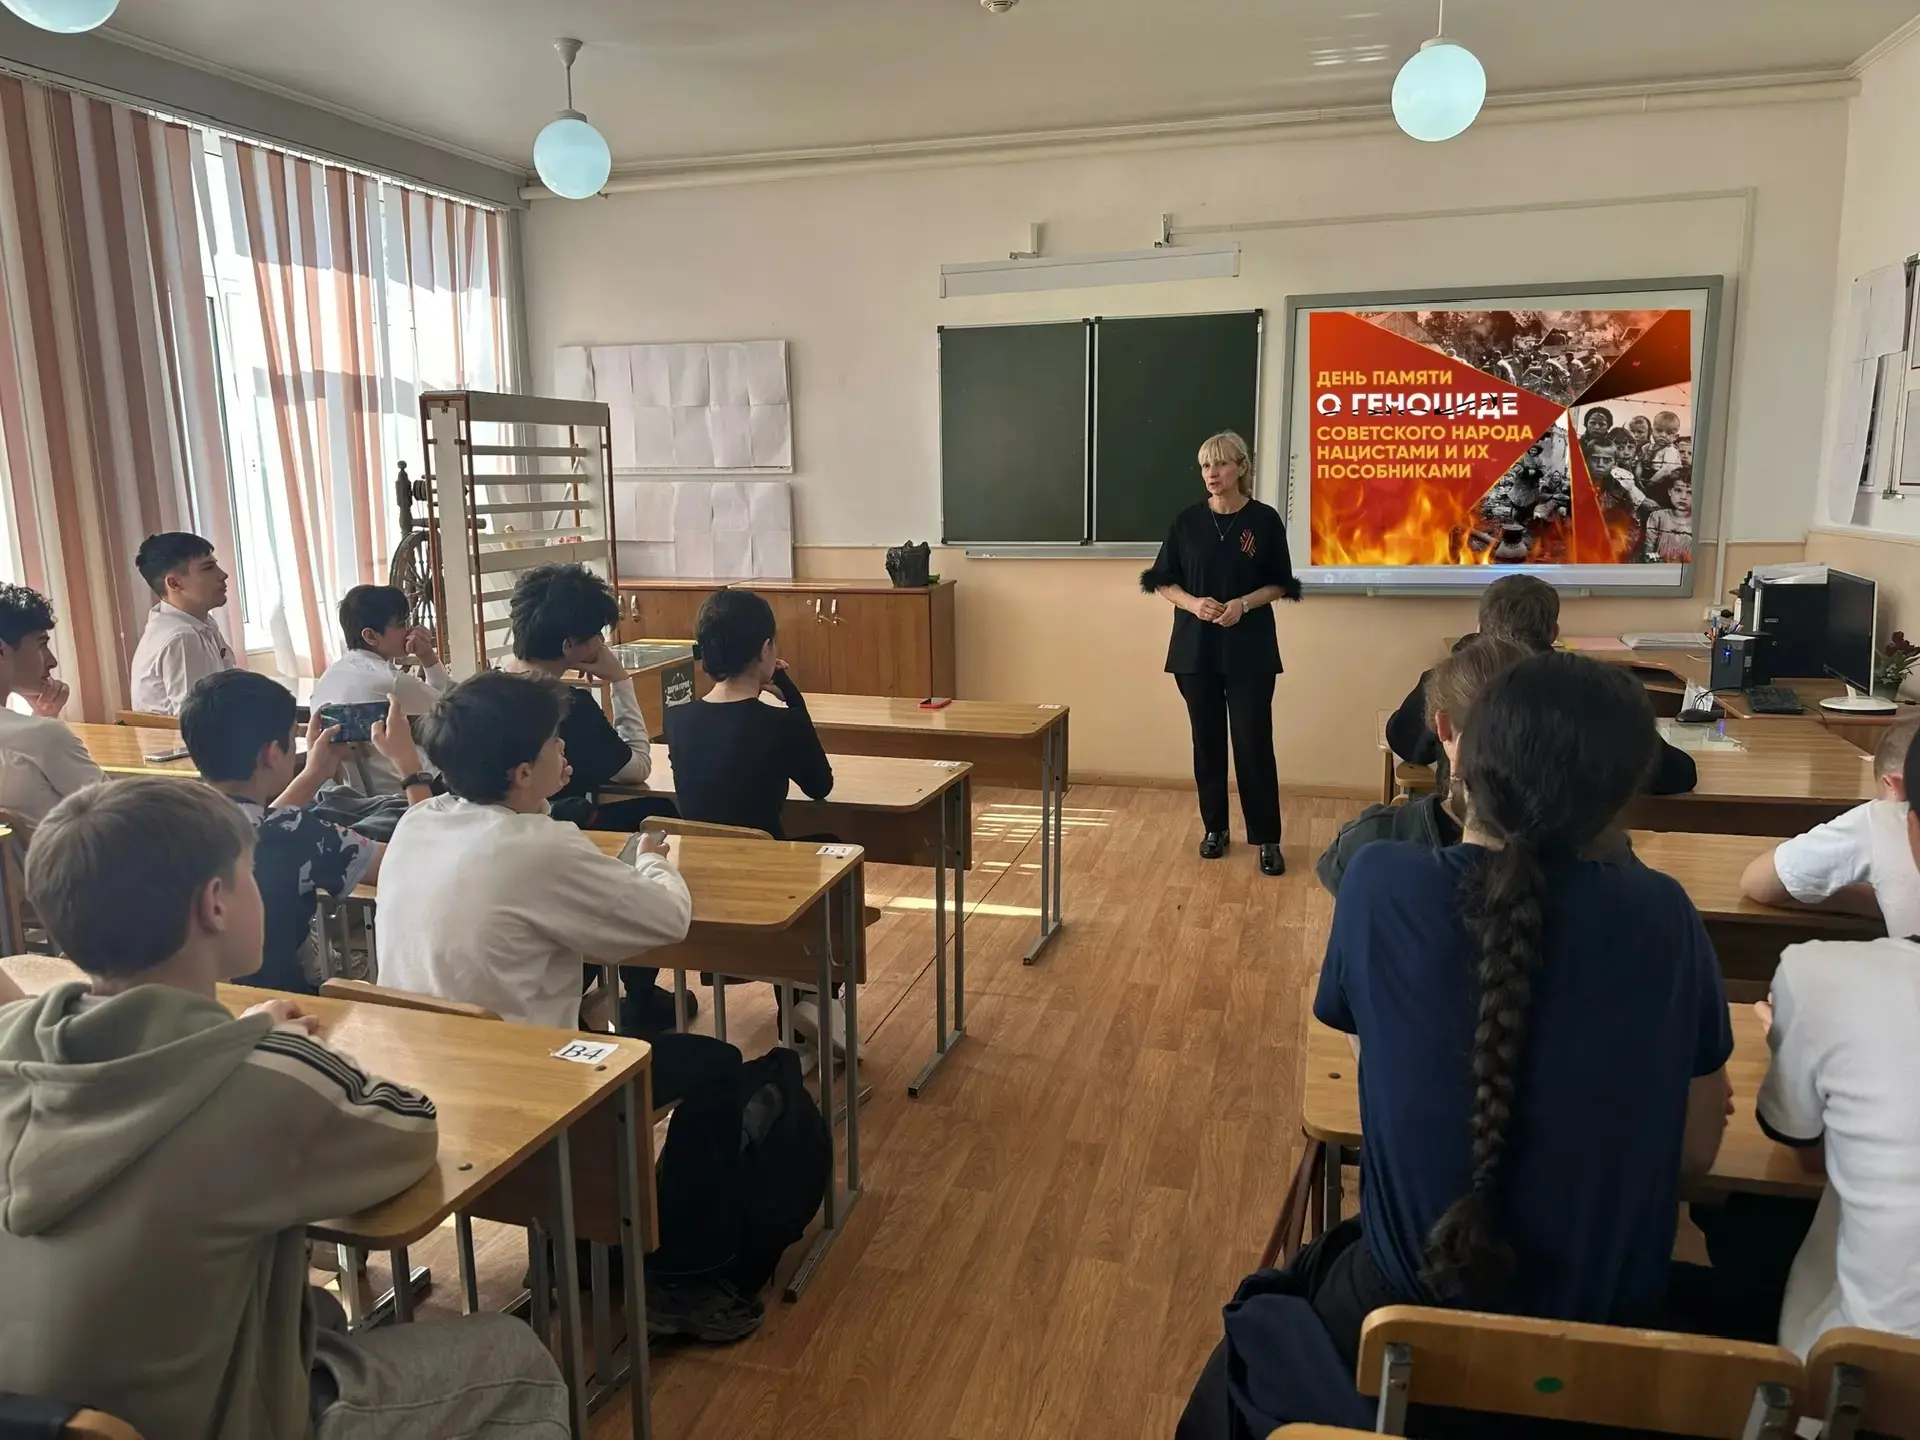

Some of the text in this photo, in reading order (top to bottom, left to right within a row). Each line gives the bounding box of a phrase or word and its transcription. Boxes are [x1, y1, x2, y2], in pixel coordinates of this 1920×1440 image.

[1316, 370, 1453, 388] ДЕНЬ ПАМЯТИ
[1316, 392, 1518, 419] О ГЕНОЦИДЕ
[1316, 425, 1534, 442] СОВЕТСКОГО НАРОДА
[1317, 444, 1489, 462] НАЦИСТАМИ И ИХ
[1317, 463, 1472, 479] ПОСОБНИКАМИ
